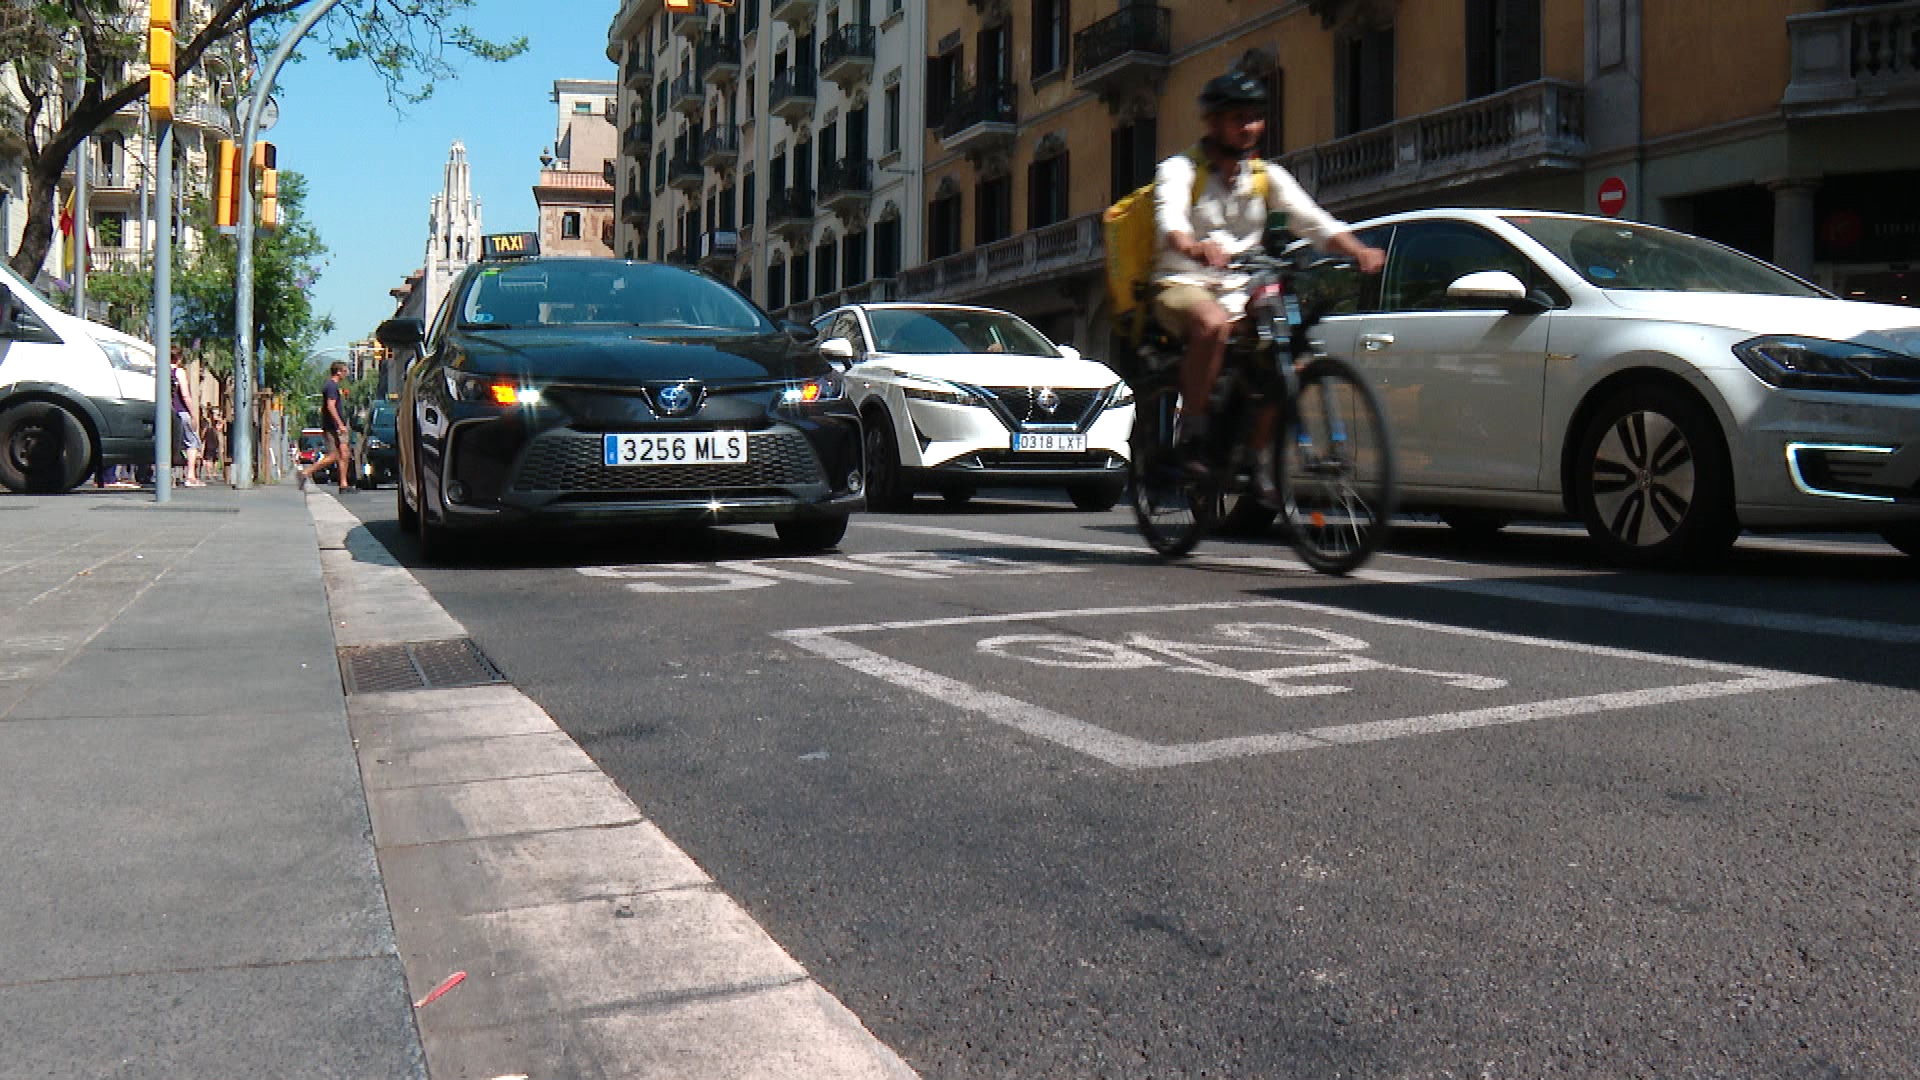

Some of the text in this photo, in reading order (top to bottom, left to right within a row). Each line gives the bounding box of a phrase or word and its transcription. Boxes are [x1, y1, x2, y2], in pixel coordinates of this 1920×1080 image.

[491, 235, 524, 253] TAXI
[623, 437, 740, 461] 3256 MLS
[1021, 435, 1053, 449] 0318
